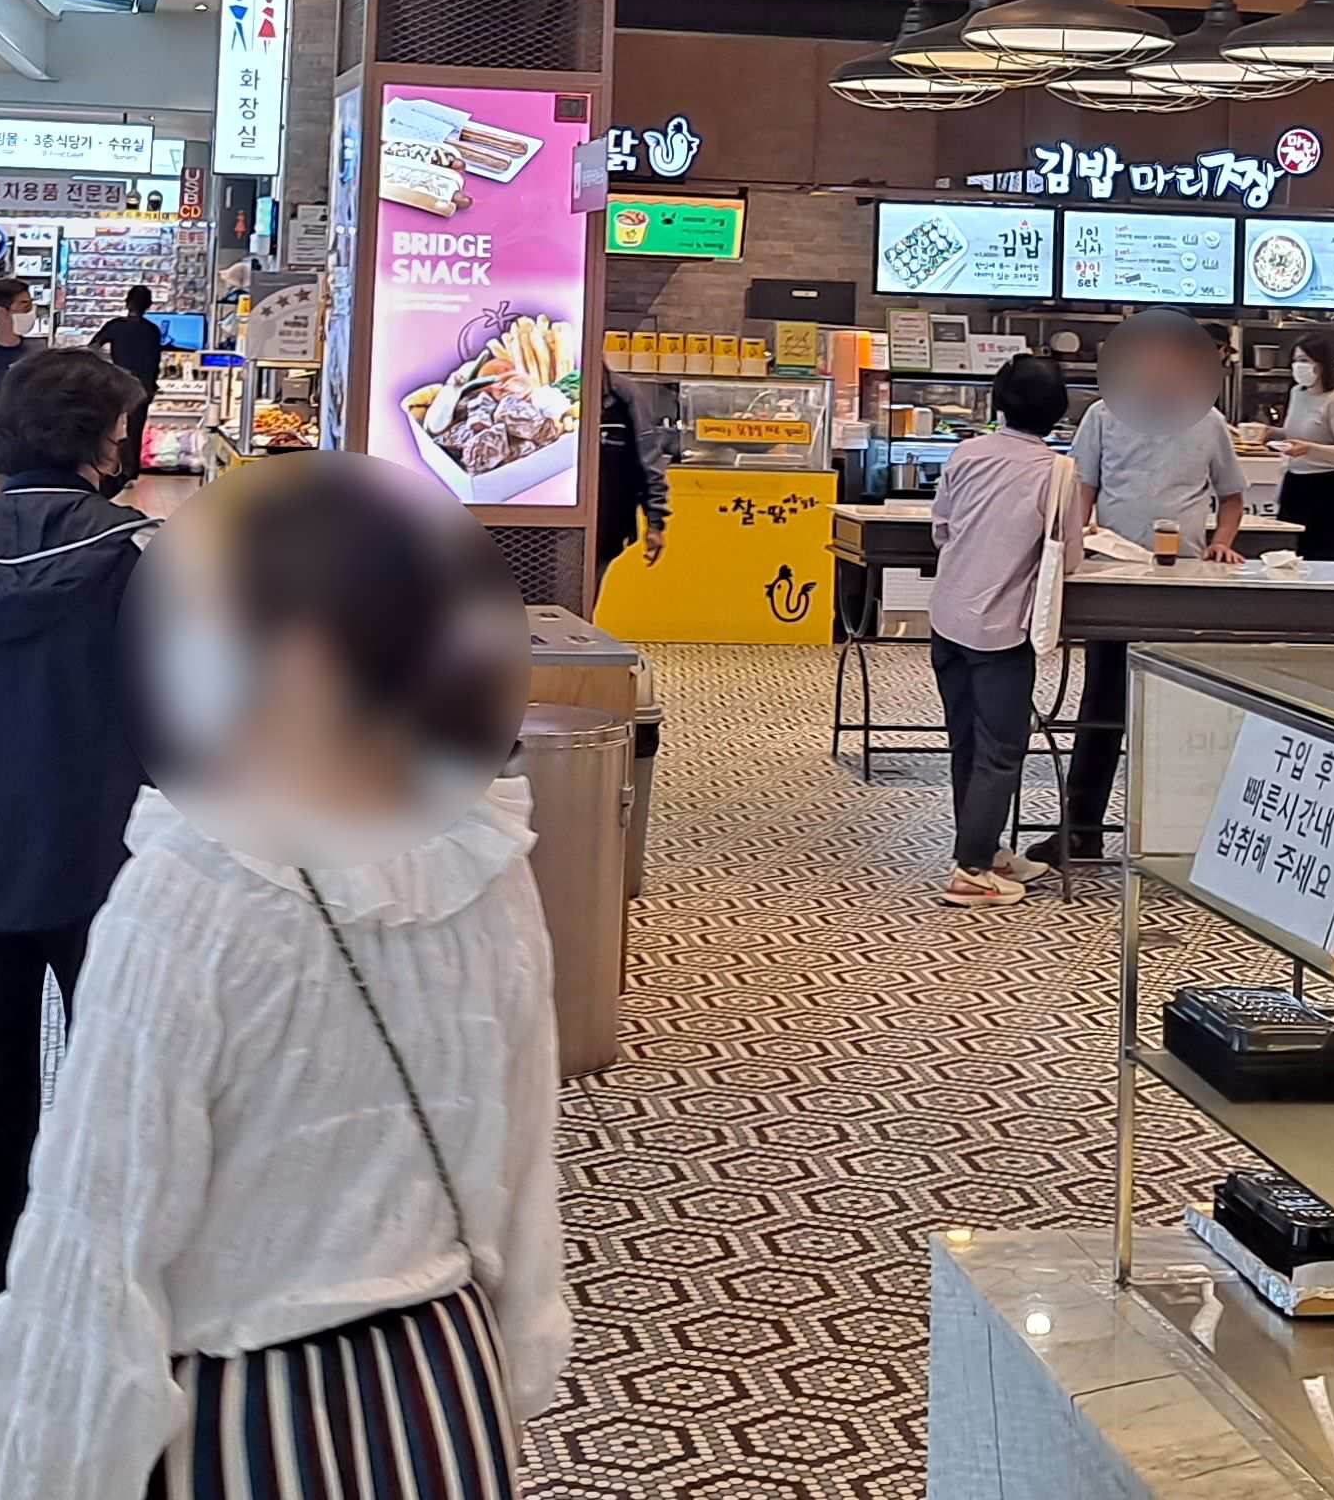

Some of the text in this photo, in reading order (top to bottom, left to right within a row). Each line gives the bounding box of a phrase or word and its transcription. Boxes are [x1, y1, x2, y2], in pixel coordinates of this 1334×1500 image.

[238, 68, 261, 149] 화장실
[34, 134, 55, 148] 3층
[108, 138, 145, 153] 수유실
[185, 168, 200, 204] USB
[1034, 141, 1286, 209] 김밥 마리짱
[67, 181, 121, 204] 전문점
[179, 204, 203, 218] CD
[392, 231, 492, 258] BRIDGE
[998, 229, 1043, 259] 김밥
[1075, 239, 1104, 256] 식사
[391, 259, 492, 286] SNACK
[1077, 278, 1099, 288] set
[1274, 735, 1313, 781] 구입
[1216, 817, 1332, 900] 섭취해 주세요
